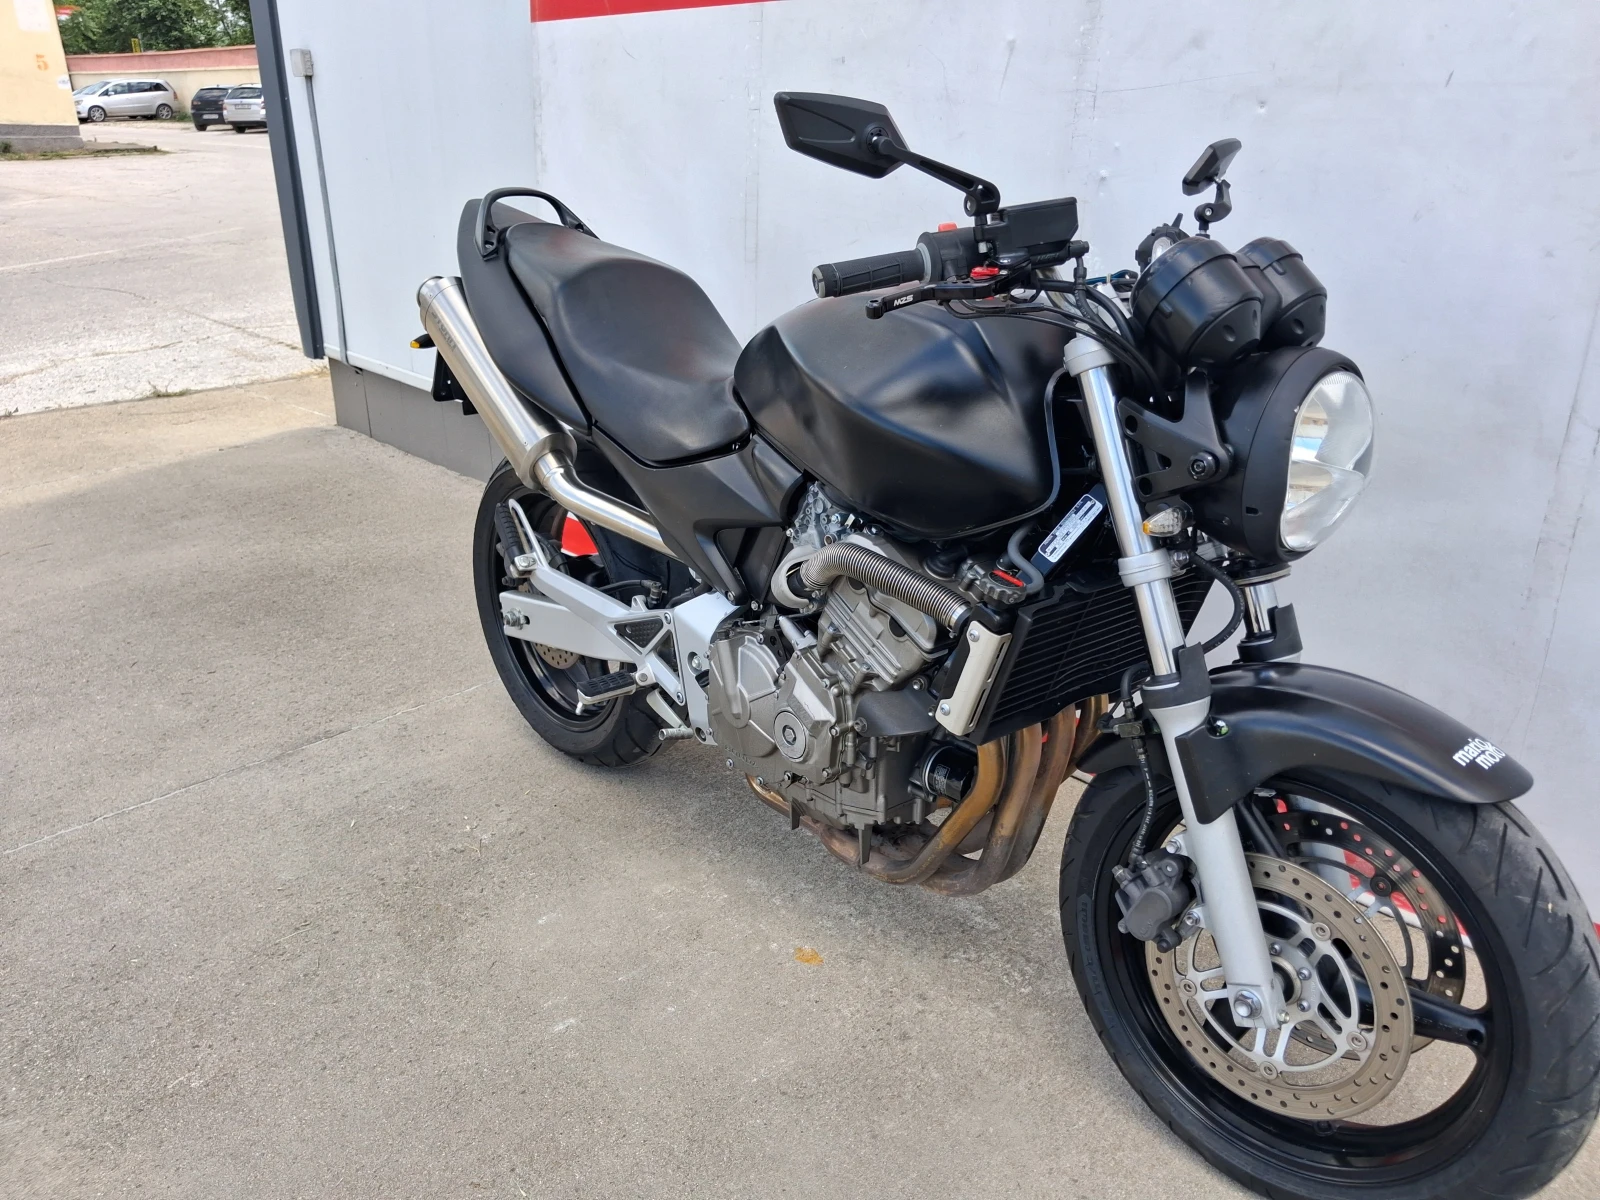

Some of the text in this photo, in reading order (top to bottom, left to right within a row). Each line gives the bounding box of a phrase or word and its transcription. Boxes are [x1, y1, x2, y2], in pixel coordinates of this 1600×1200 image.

[35, 53, 49, 71] 5
[893, 294, 914, 307] MZS
[1452, 738, 1487, 767] mario
